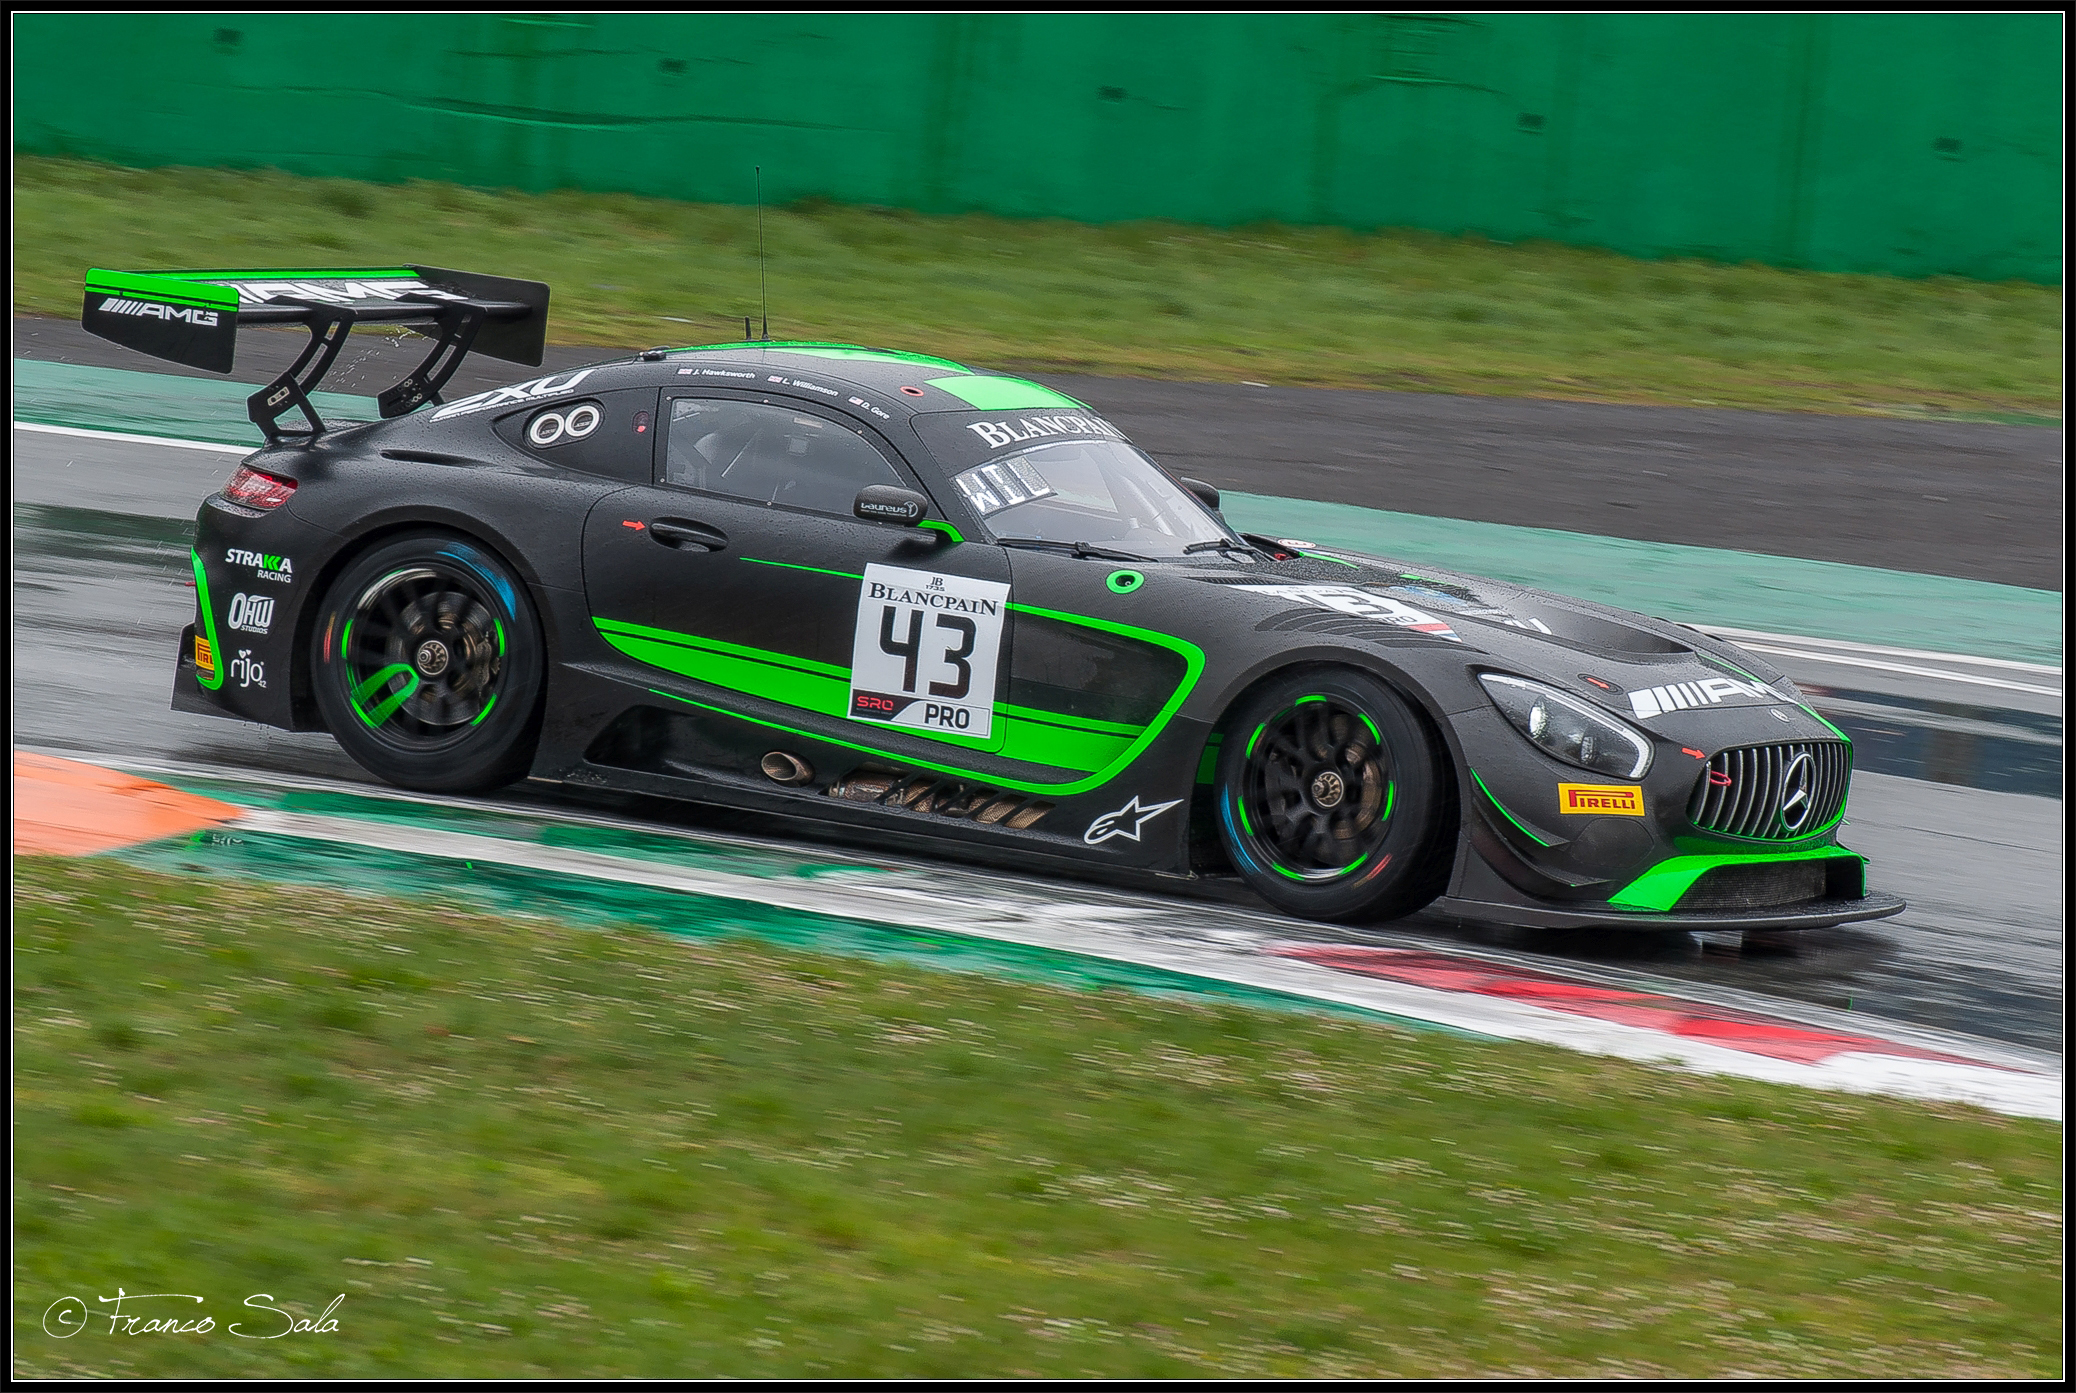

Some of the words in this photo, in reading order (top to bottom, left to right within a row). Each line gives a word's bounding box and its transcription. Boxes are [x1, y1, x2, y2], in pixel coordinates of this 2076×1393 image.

[134, 302, 219, 326] AMG
[692, 368, 700, 376] J.
[702, 369, 756, 379] Hawksworth
[781, 377, 790, 385] L.
[792, 379, 839, 397] Williamson
[861, 401, 870, 411] D.
[870, 405, 891, 420] Gore
[225, 548, 293, 574] STRAKKA
[257, 569, 292, 583] RACING
[925, 584, 945, 592] 1735
[868, 582, 998, 616] BLANCPAIN
[241, 624, 269, 635] STUDIOS
[879, 605, 977, 700] 43
[856, 695, 894, 711] SRO
[924, 702, 970, 730] PRO
[1568, 789, 1636, 810] PIRELLI
